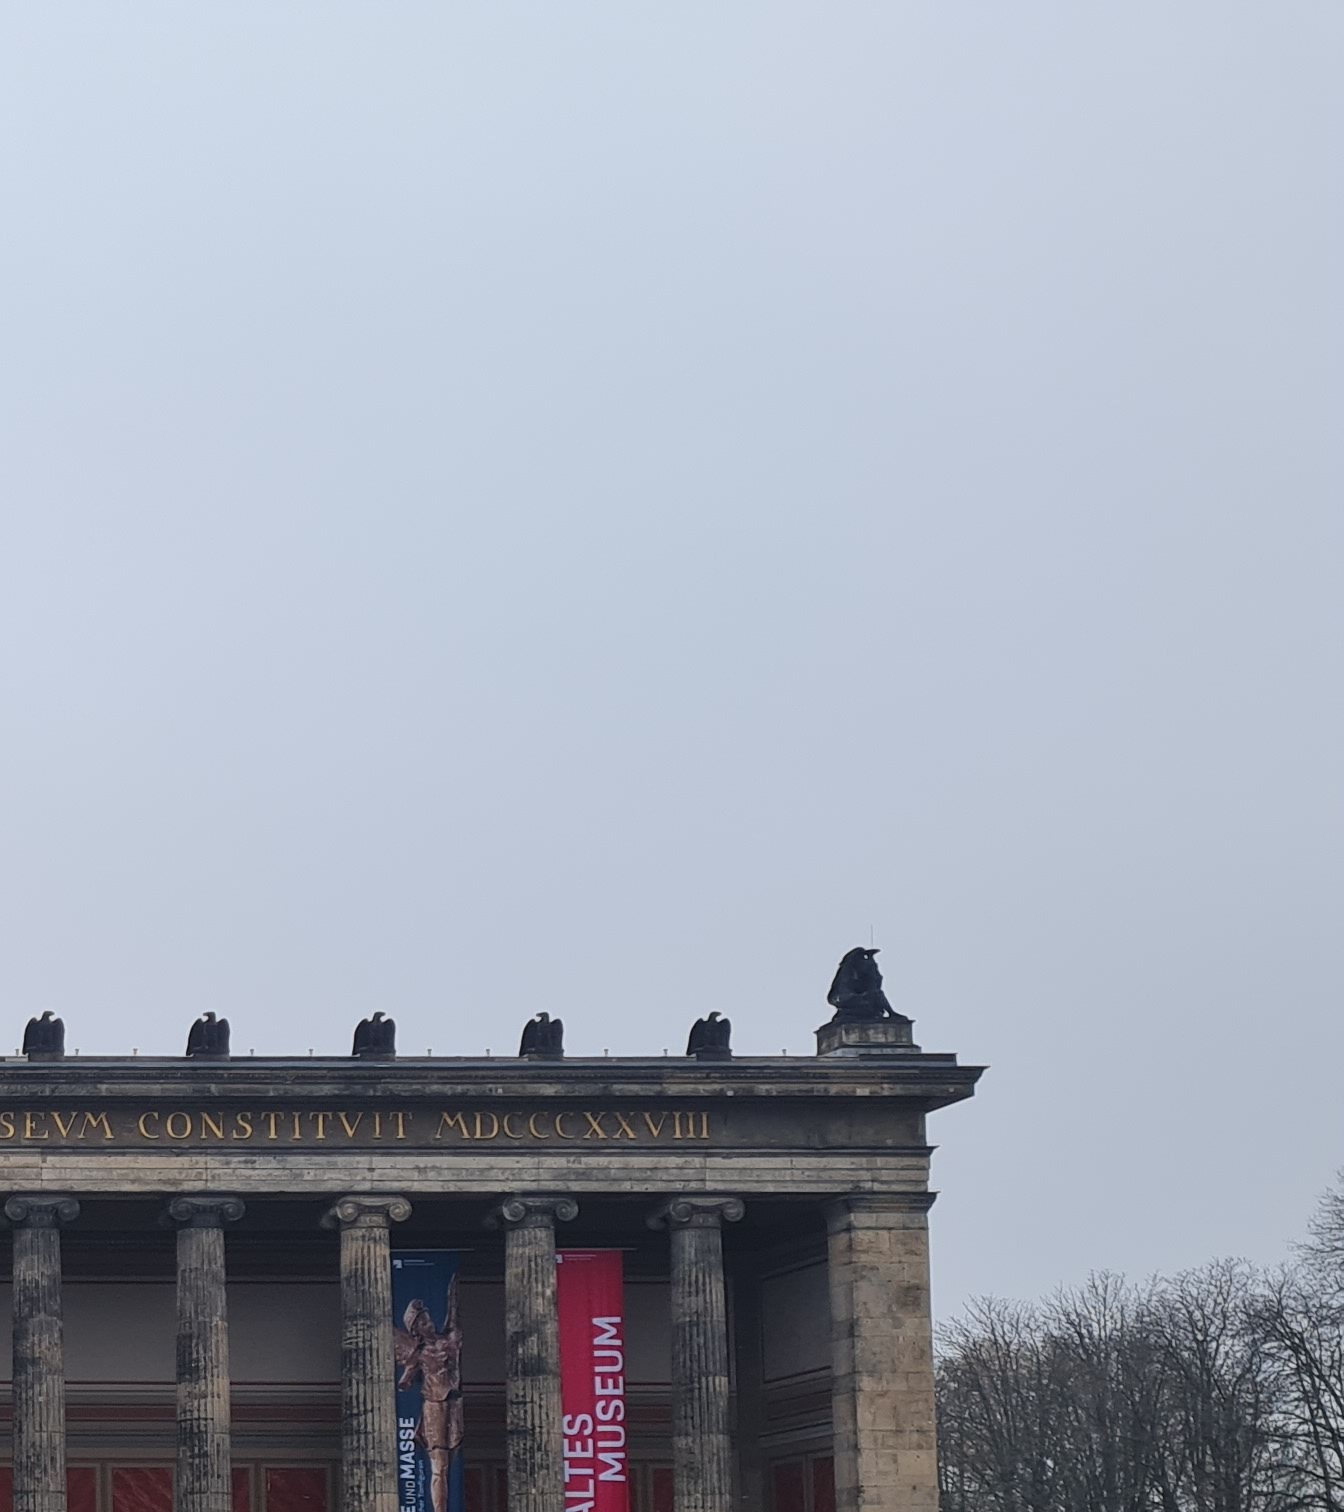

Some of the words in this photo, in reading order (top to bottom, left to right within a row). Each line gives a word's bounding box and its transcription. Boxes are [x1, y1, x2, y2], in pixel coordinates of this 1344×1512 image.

[138, 1111, 412, 1141] CONSTITVIT
[436, 1111, 710, 1141] MDCCCXXVIII
[592, 1316, 626, 1483] MUSEUM
[399, 1417, 416, 1479] MASSE
[405, 1480, 416, 1504] UND
